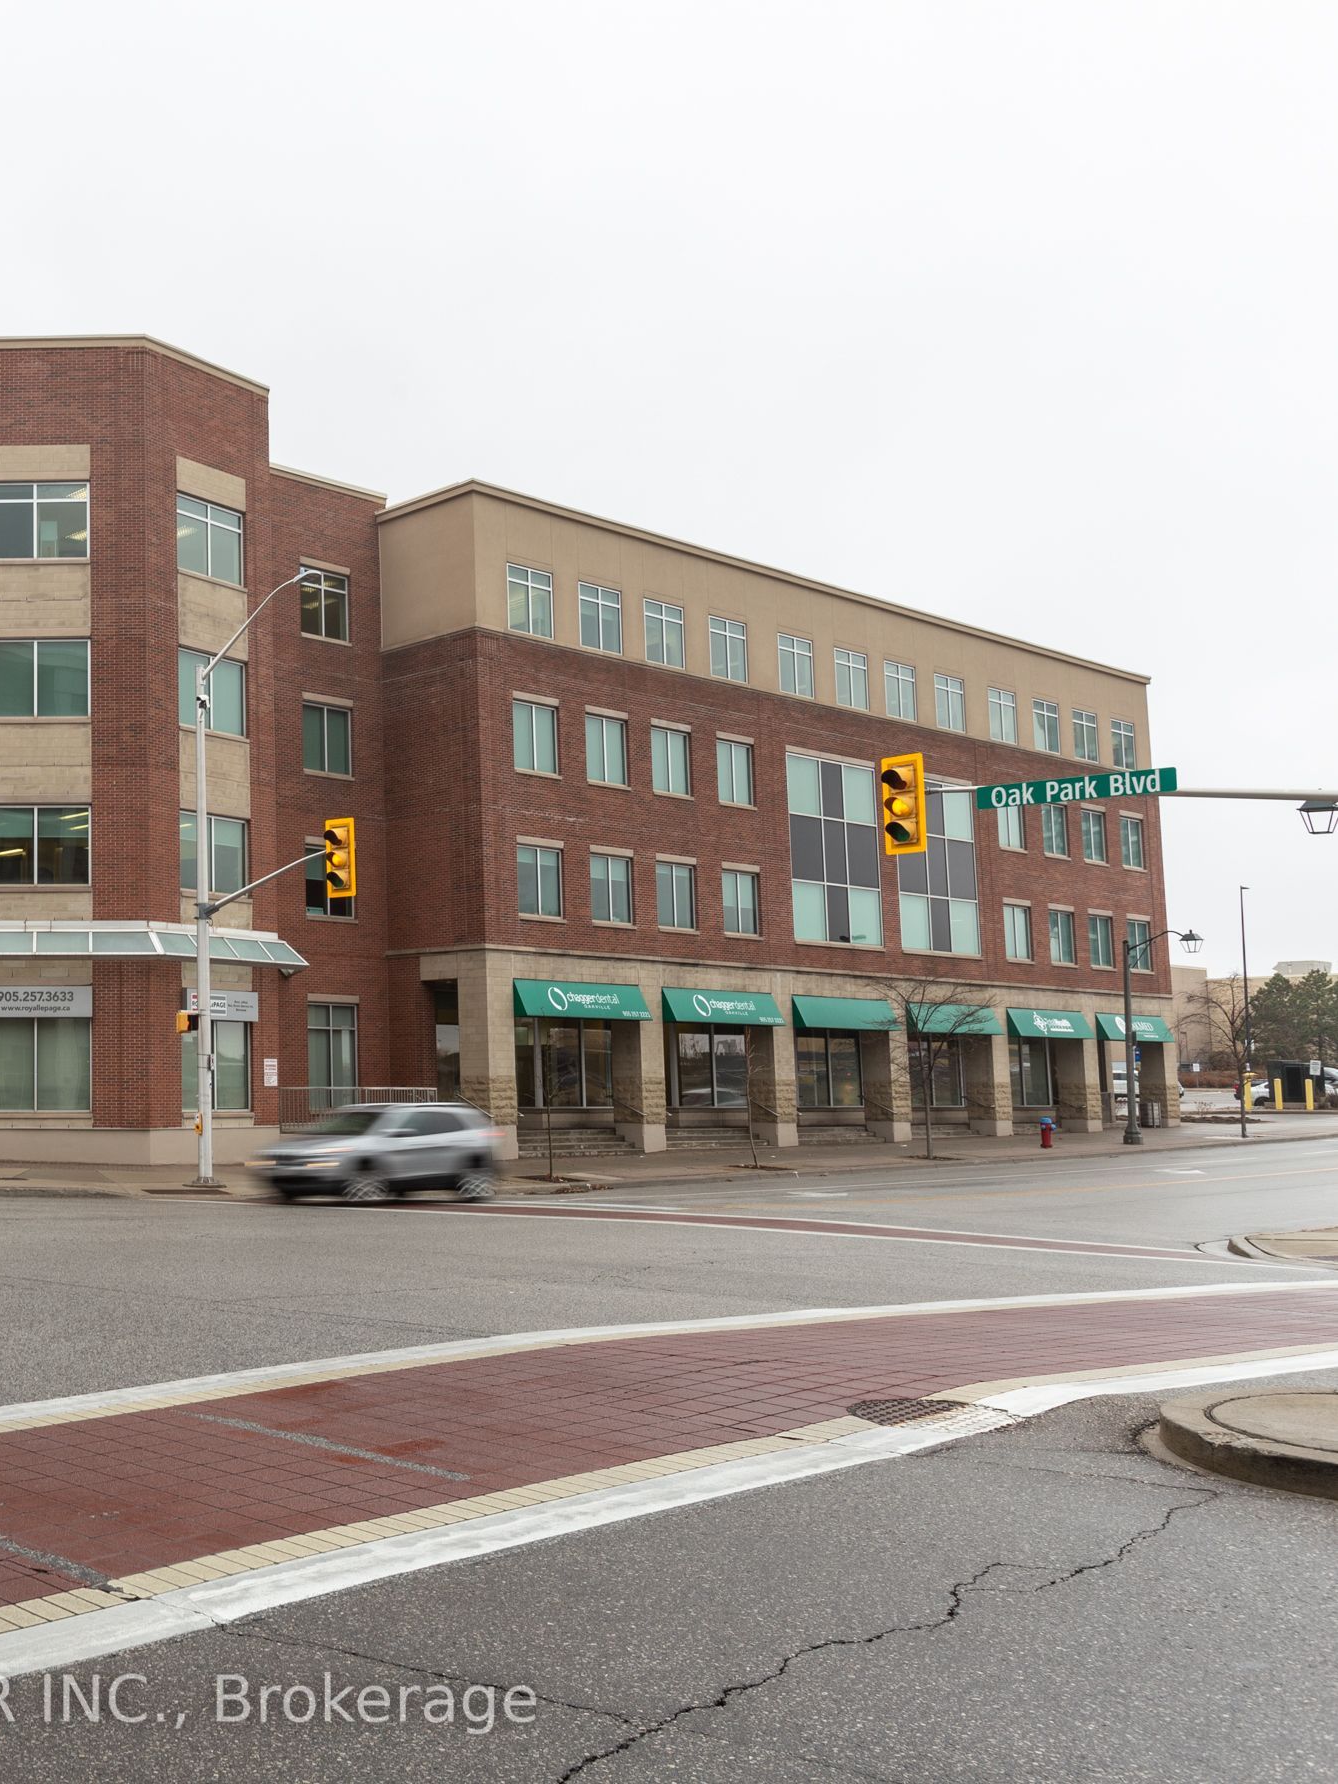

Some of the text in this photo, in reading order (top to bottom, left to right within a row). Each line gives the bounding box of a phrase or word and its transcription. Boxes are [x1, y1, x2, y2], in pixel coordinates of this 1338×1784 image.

[991, 769, 1161, 808] Oak Park Blvd
[566, 991, 620, 1004] chaggerdental
